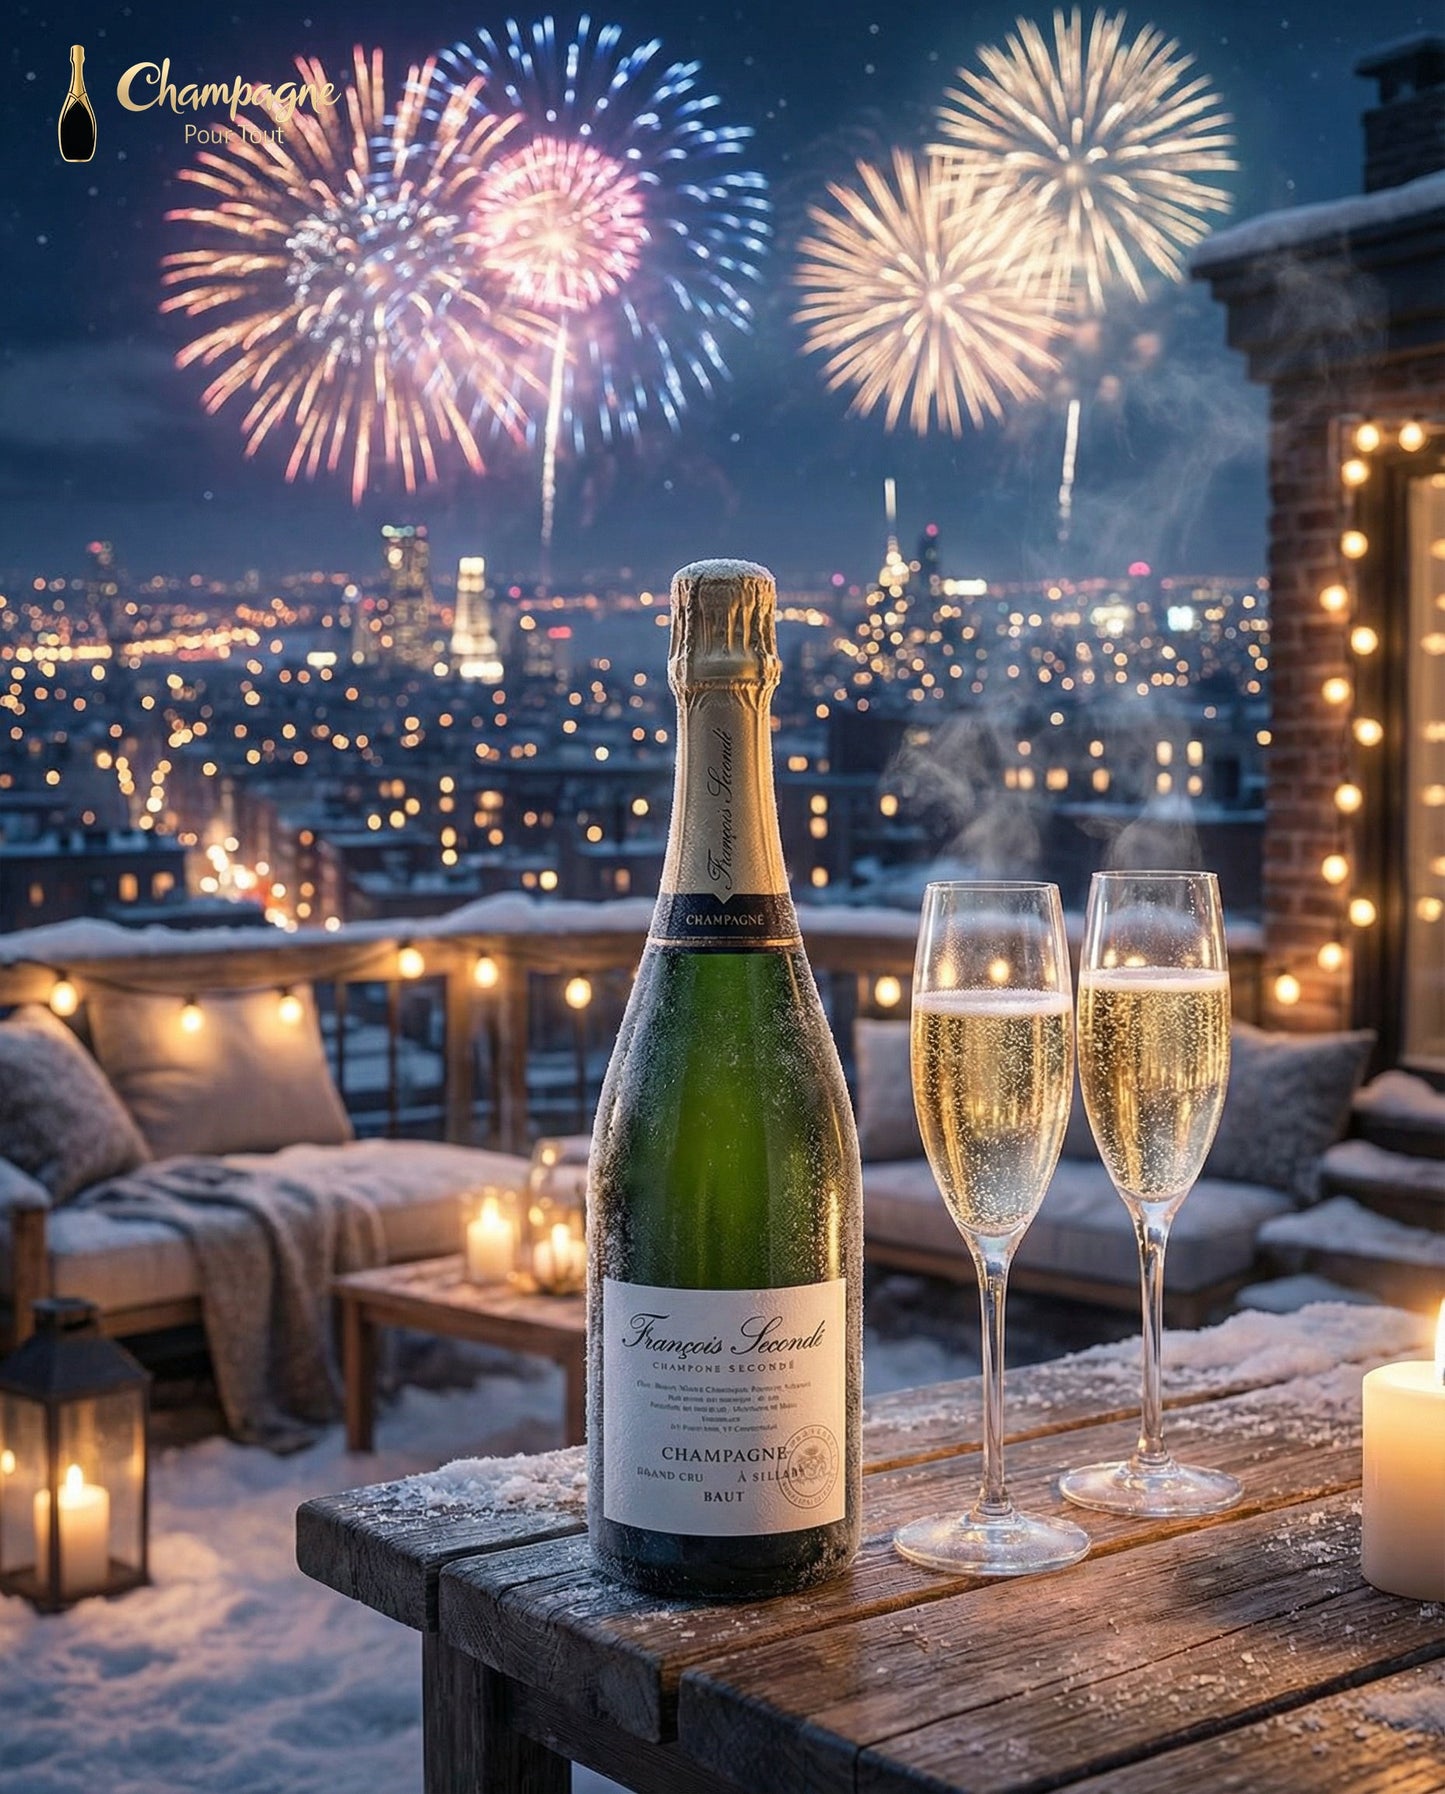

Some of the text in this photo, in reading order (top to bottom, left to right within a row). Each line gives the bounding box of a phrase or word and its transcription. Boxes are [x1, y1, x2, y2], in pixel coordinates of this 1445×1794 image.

[686, 914, 765, 926] CHAMPAGNE
[622, 1312, 723, 1360] François
[661, 1446, 788, 1463] CHAMPAGNE
[679, 1472, 704, 1483] CRU
[704, 1491, 745, 1503] BAUT
